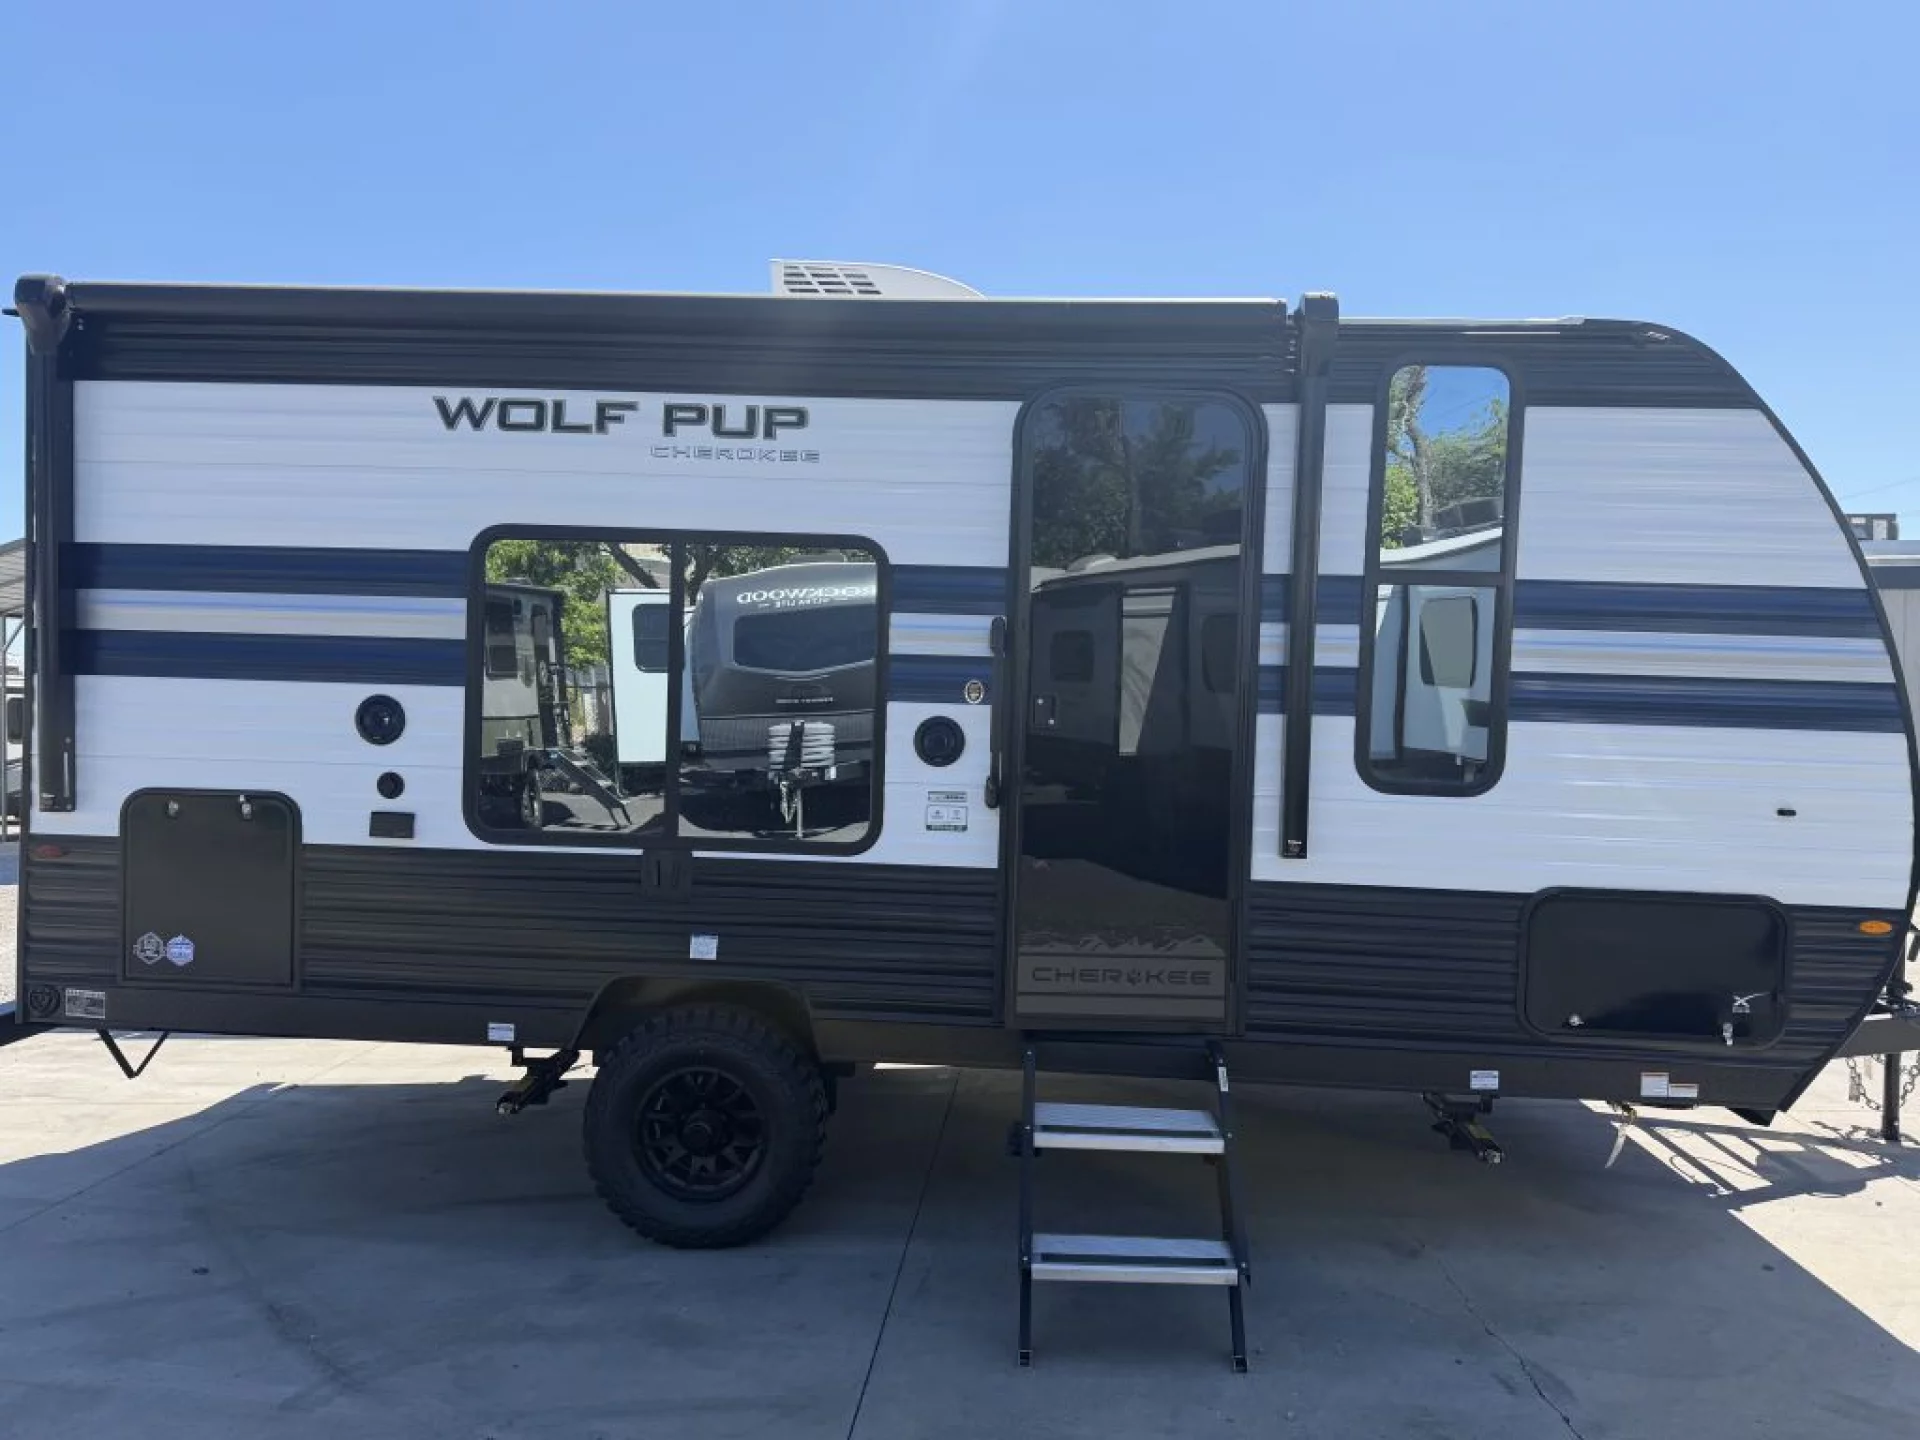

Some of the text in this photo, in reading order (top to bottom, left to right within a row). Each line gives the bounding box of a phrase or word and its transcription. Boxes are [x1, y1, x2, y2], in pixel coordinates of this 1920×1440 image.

[433, 396, 809, 440] WOLF PUP
[649, 445, 821, 463] CHEROKEE
